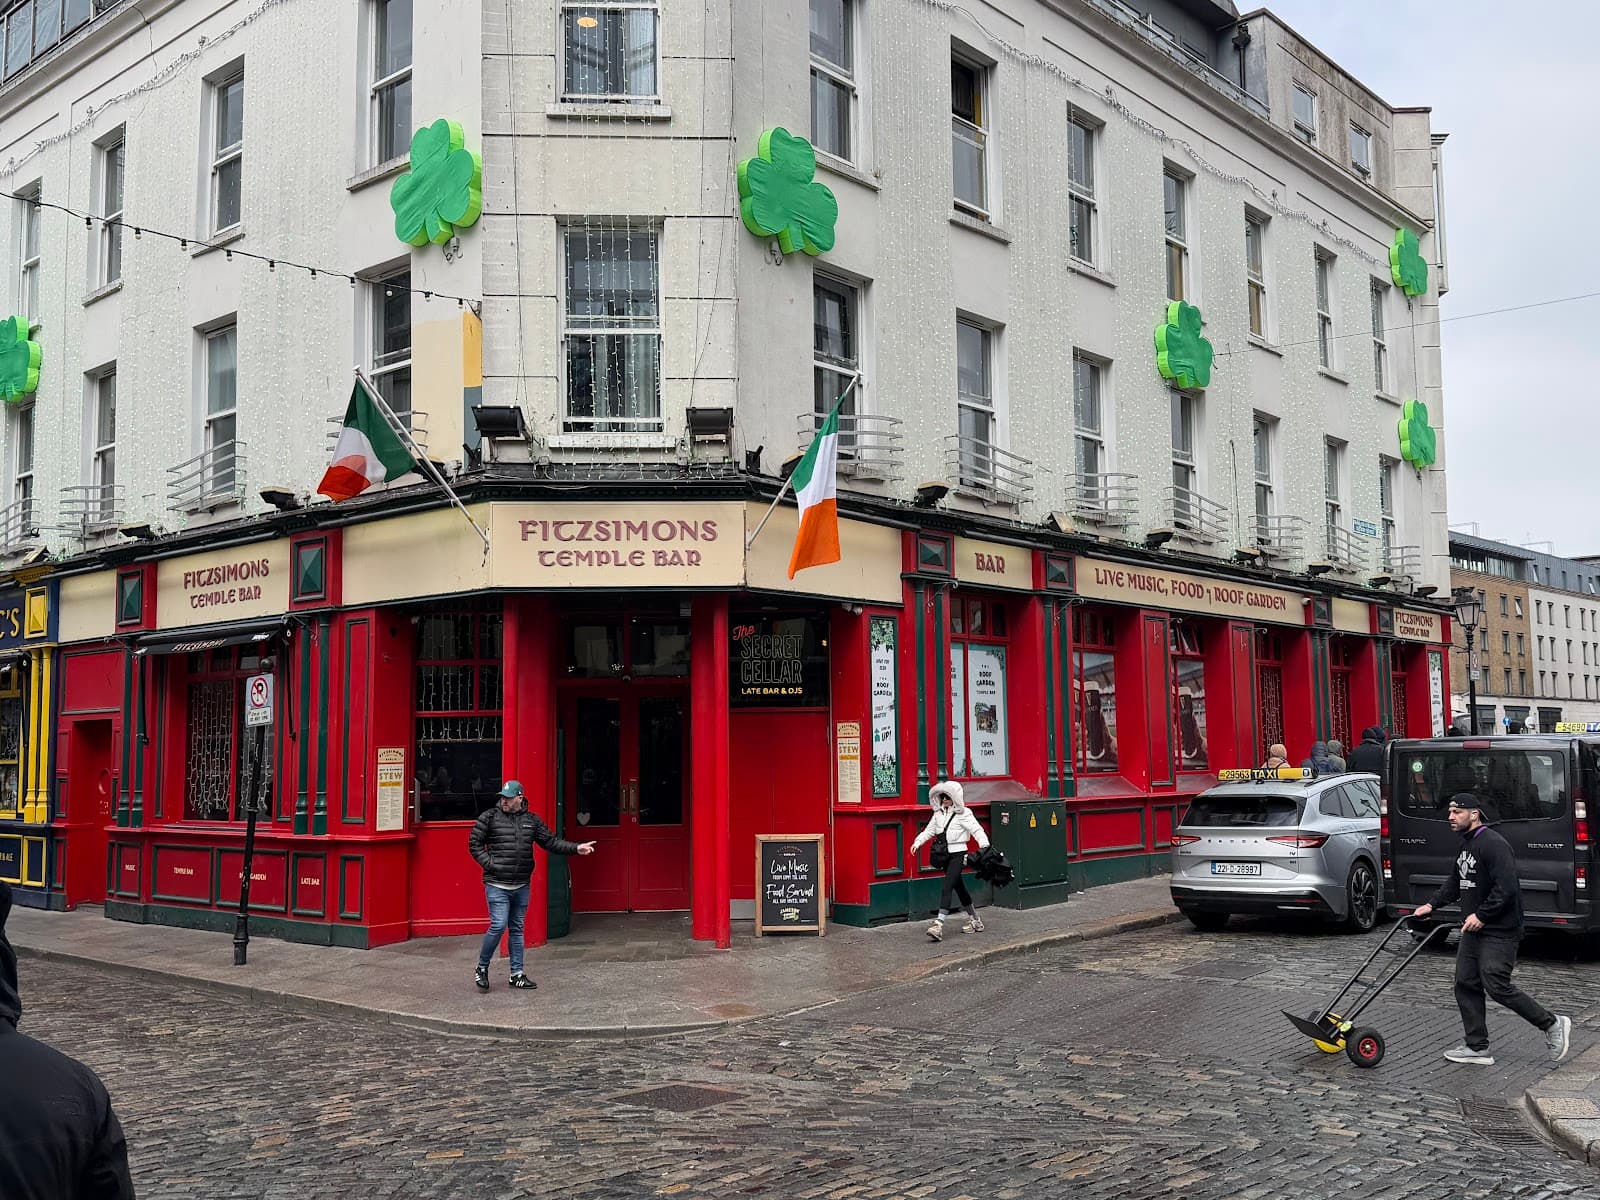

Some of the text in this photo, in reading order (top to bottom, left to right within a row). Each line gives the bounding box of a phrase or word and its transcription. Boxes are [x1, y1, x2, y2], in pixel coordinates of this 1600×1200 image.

[518, 520, 718, 541] FITZSIMONS
[538, 550, 702, 567] TEMPLE BAR
[975, 553, 1005, 574] BAR
[184, 559, 269, 590] FITZSIMONS
[190, 585, 262, 609] TEMPLE BAR
[1094, 568, 1125, 588] LIVE
[1170, 579, 1204, 599] FOOD
[1213, 586, 1244, 605] ROOF
[1246, 590, 1286, 611] GARDEN
[1395, 612, 1433, 628] FITZSIMONS
[732, 625, 756, 640] The
[740, 634, 803, 659] SECRET
[740, 659, 803, 684] CELLAR
[741, 687, 761, 695] LATE
[762, 687, 780, 695] BAR
[780, 687, 788, 695] &
[839, 746, 859, 754] STEW
[379, 772, 403, 780] STEW
[1251, 769, 1277, 779] TAXI
[771, 859, 808, 875] Live Music
[766, 884, 814, 899] Food Served
